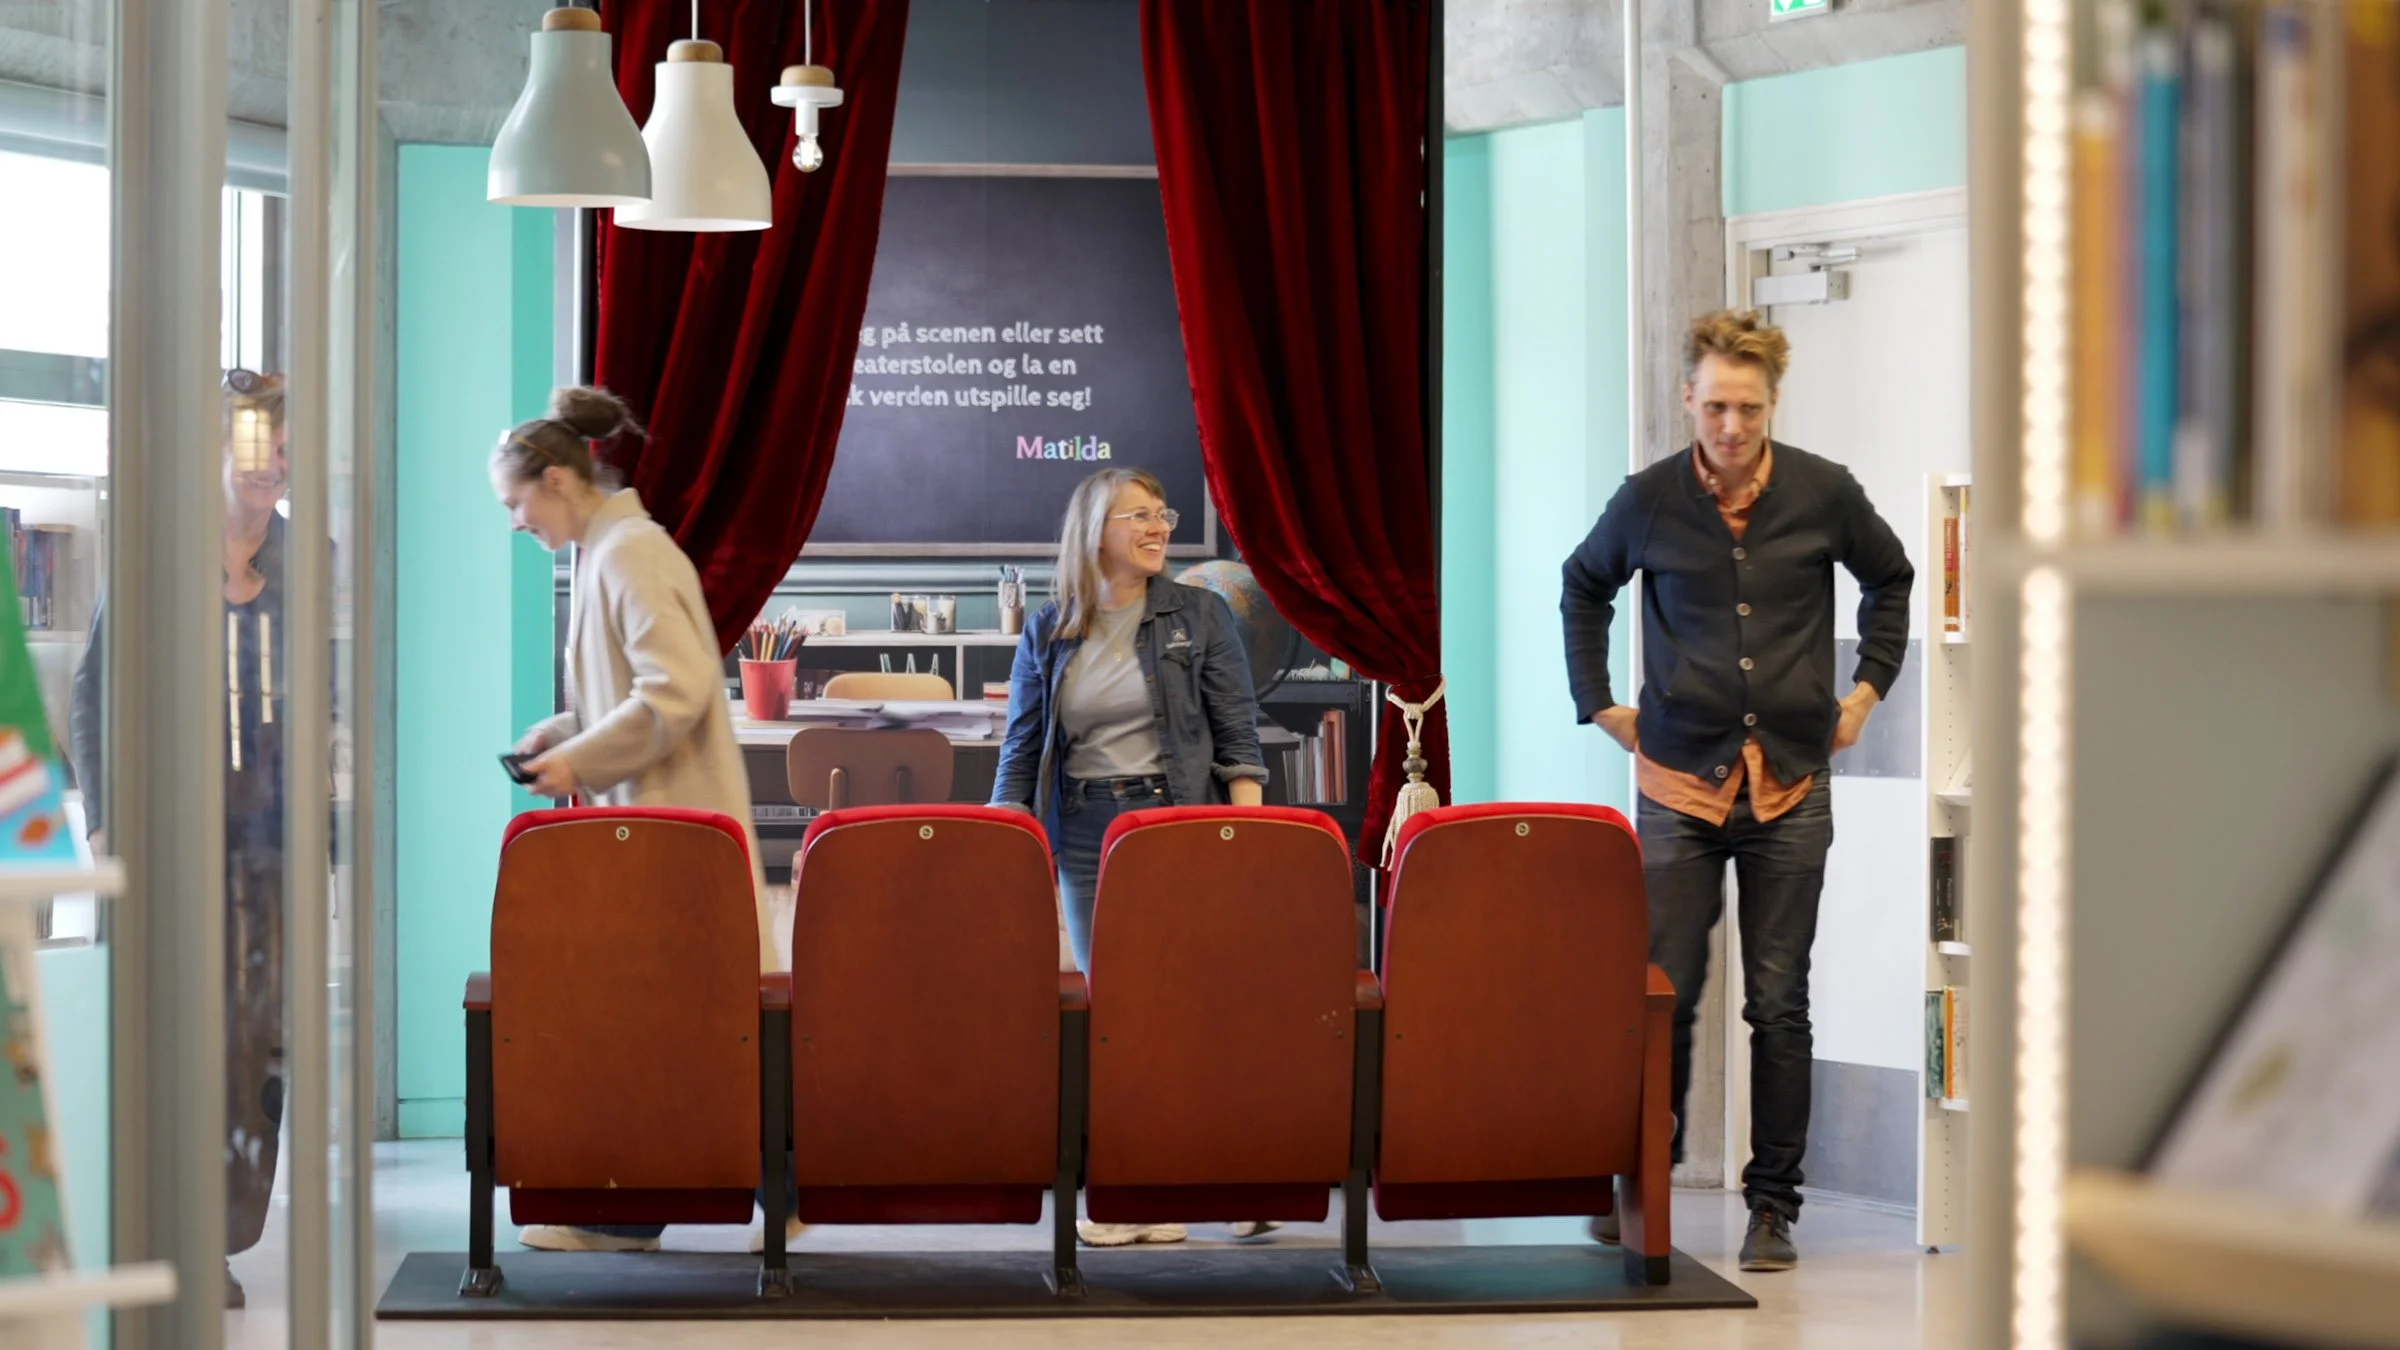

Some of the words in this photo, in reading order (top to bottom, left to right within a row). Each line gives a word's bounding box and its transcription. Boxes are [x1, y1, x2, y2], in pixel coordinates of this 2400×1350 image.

[859, 327, 877, 348] g
[881, 322, 911, 349] på
[916, 326, 996, 344] scenen
[1002, 322, 1053, 344] eller
[1058, 324, 1104, 344] sett
[854, 354, 982, 376] eaterstolen
[988, 358, 1016, 379] og
[1022, 354, 1044, 375] la
[1049, 358, 1077, 375] en
[869, 385, 949, 407] verden
[955, 385, 1041, 412] utspille
[1046, 387, 1091, 411] seg!
[1016, 436, 1111, 461] Matilda
